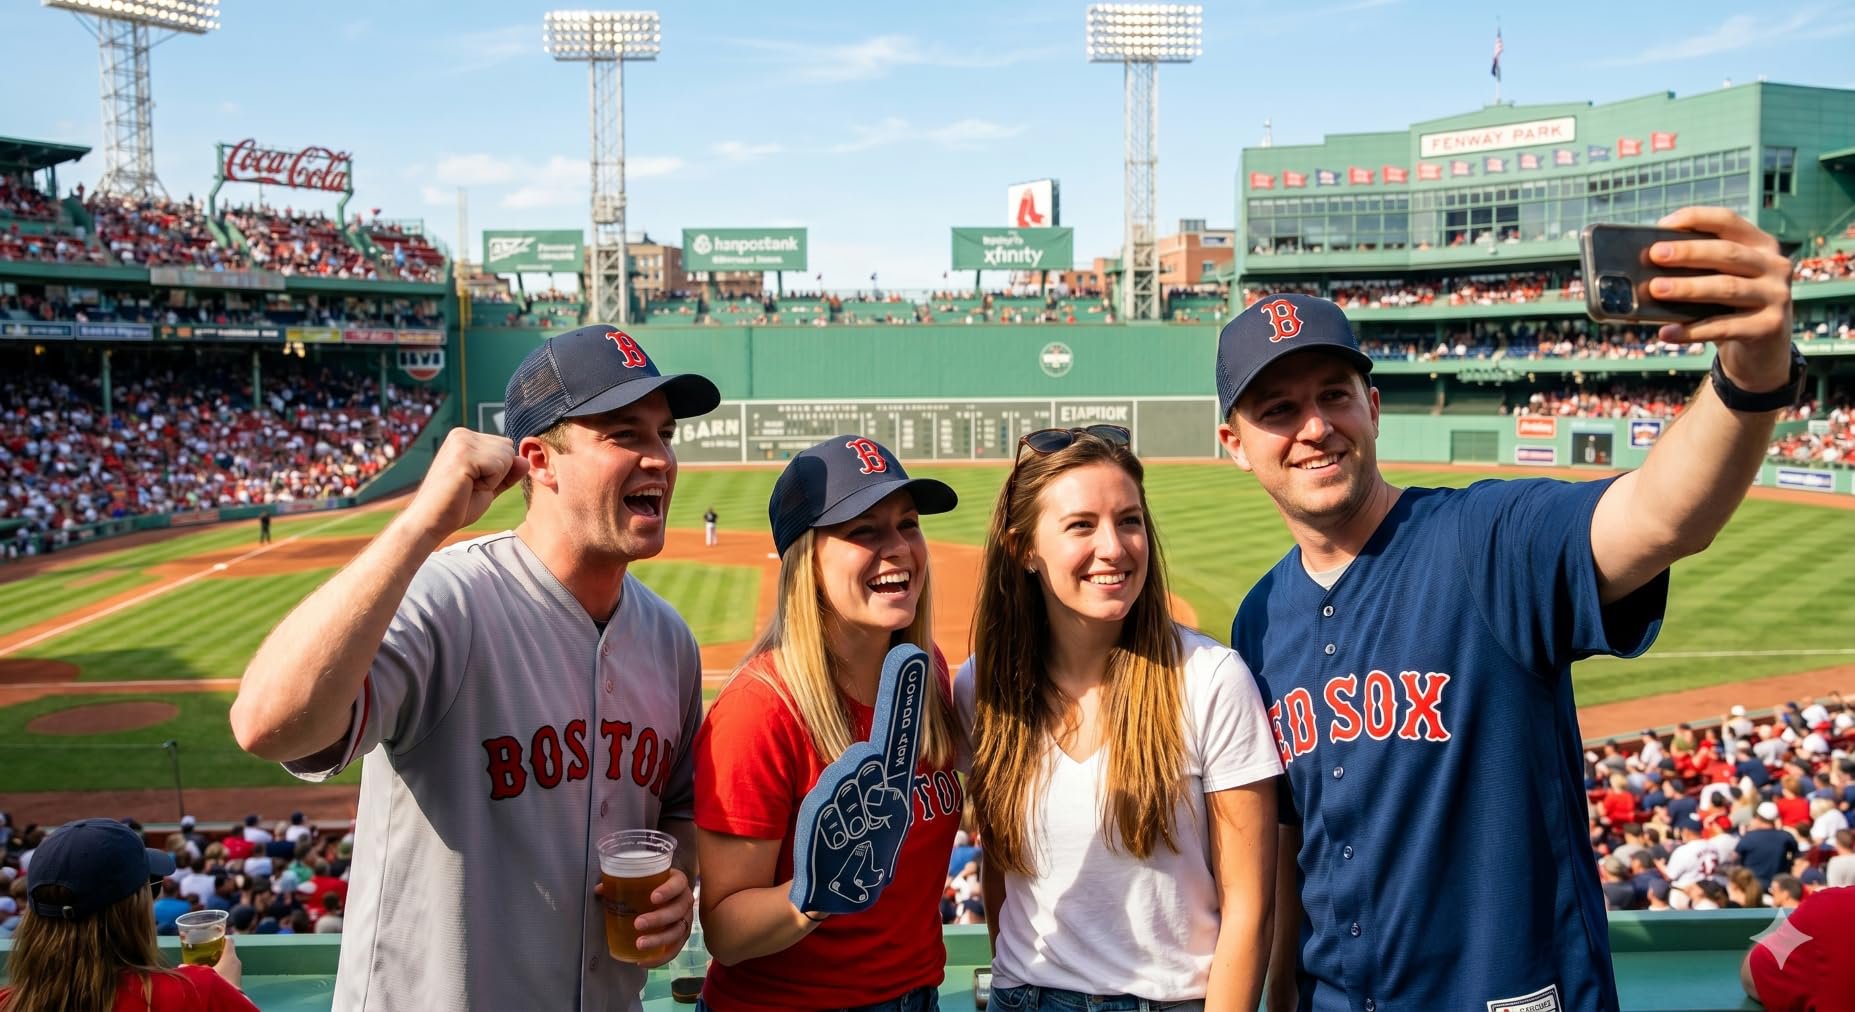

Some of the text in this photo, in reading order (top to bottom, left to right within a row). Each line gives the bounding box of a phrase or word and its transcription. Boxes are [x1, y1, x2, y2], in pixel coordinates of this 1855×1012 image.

[1432, 125, 1562, 151] FENWAY PARK
[984, 246, 1043, 268] xfinity
[1261, 299, 1304, 342] B
[605, 331, 647, 368] B
[846, 438, 887, 474] B
[1268, 669, 1451, 769] ED SOX
